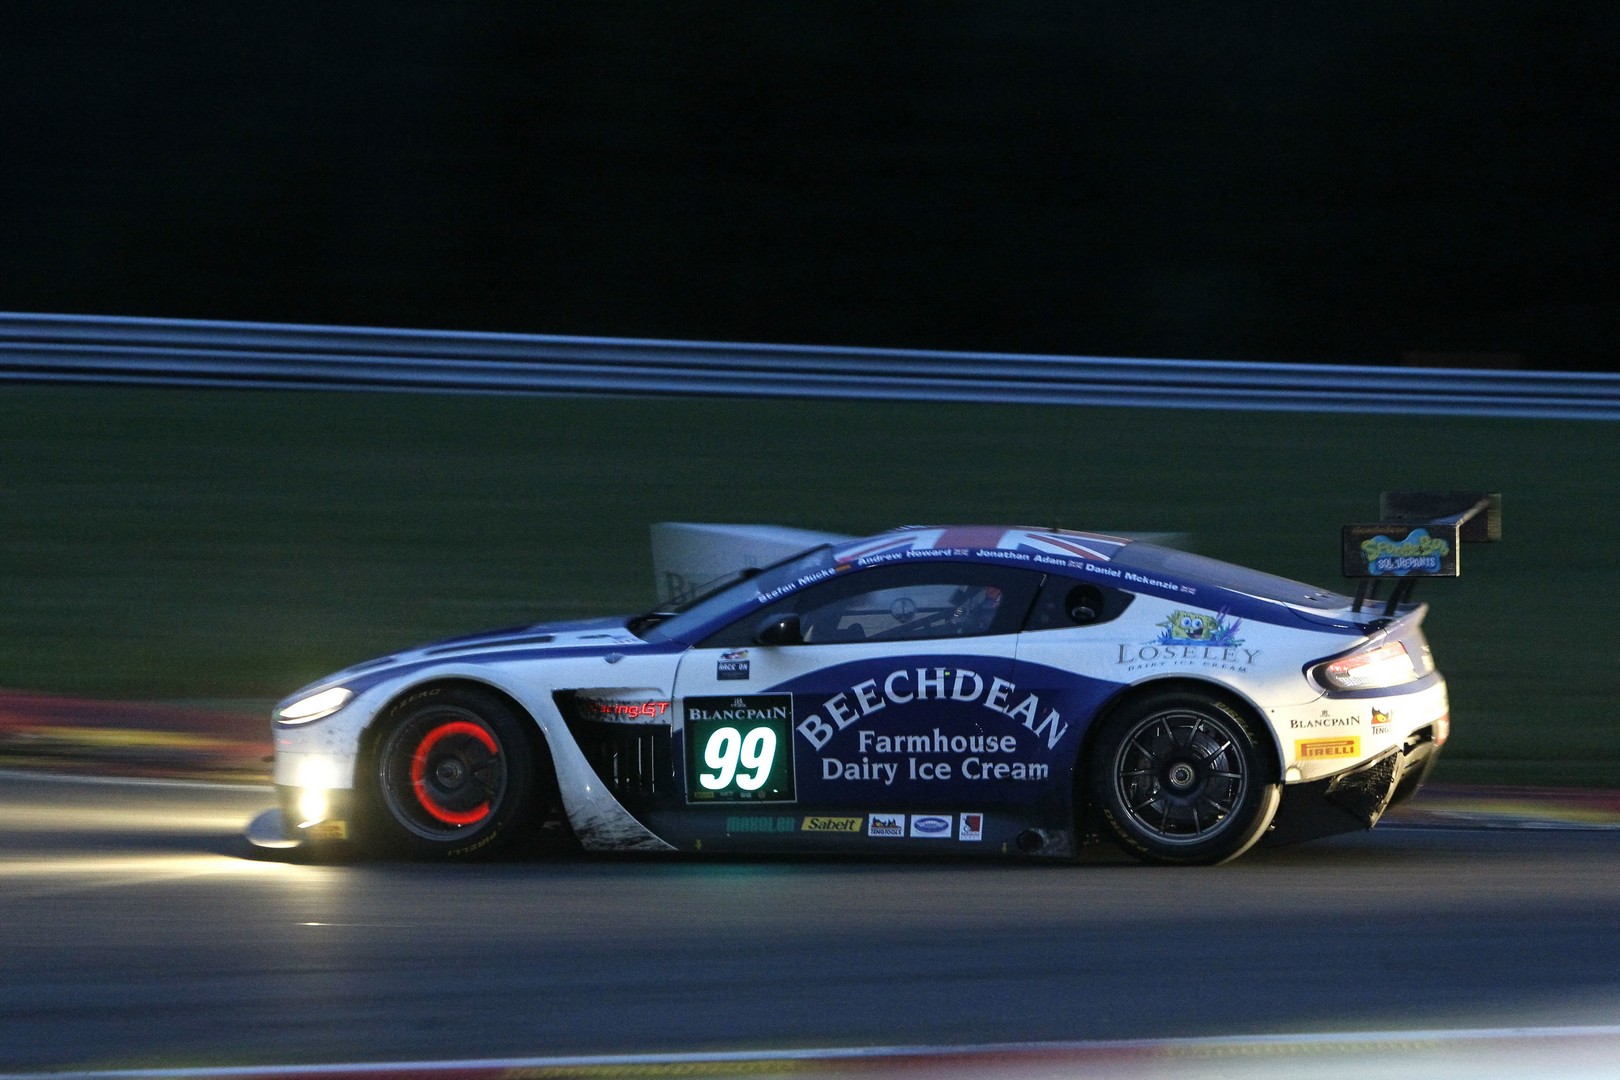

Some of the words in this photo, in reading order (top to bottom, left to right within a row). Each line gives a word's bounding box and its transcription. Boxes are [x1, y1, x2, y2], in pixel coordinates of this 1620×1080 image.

[757, 582, 796, 603] Stefan
[858, 550, 902, 567] Andrew
[906, 548, 952, 560] Howard
[976, 549, 1030, 561] Jonathan
[1033, 553, 1067, 567] Adam
[1085, 563, 1121, 578] Daniel
[1116, 643, 1261, 665] LOSELEY
[1128, 661, 1165, 671] DAIRY
[1202, 661, 1247, 673] CREAM
[689, 706, 787, 721] BLANCPAIN
[796, 667, 1069, 751] BEECHDEAN
[1290, 716, 1360, 729] BLANCPAIN
[858, 728, 1017, 753] Farmhouse
[1300, 740, 1355, 757] PIRELLI
[700, 726, 777, 791] 99
[821, 756, 898, 786] Dairy
[909, 757, 952, 780] Ice
[961, 756, 1049, 781] Cream
[808, 816, 856, 831] Sabelt
